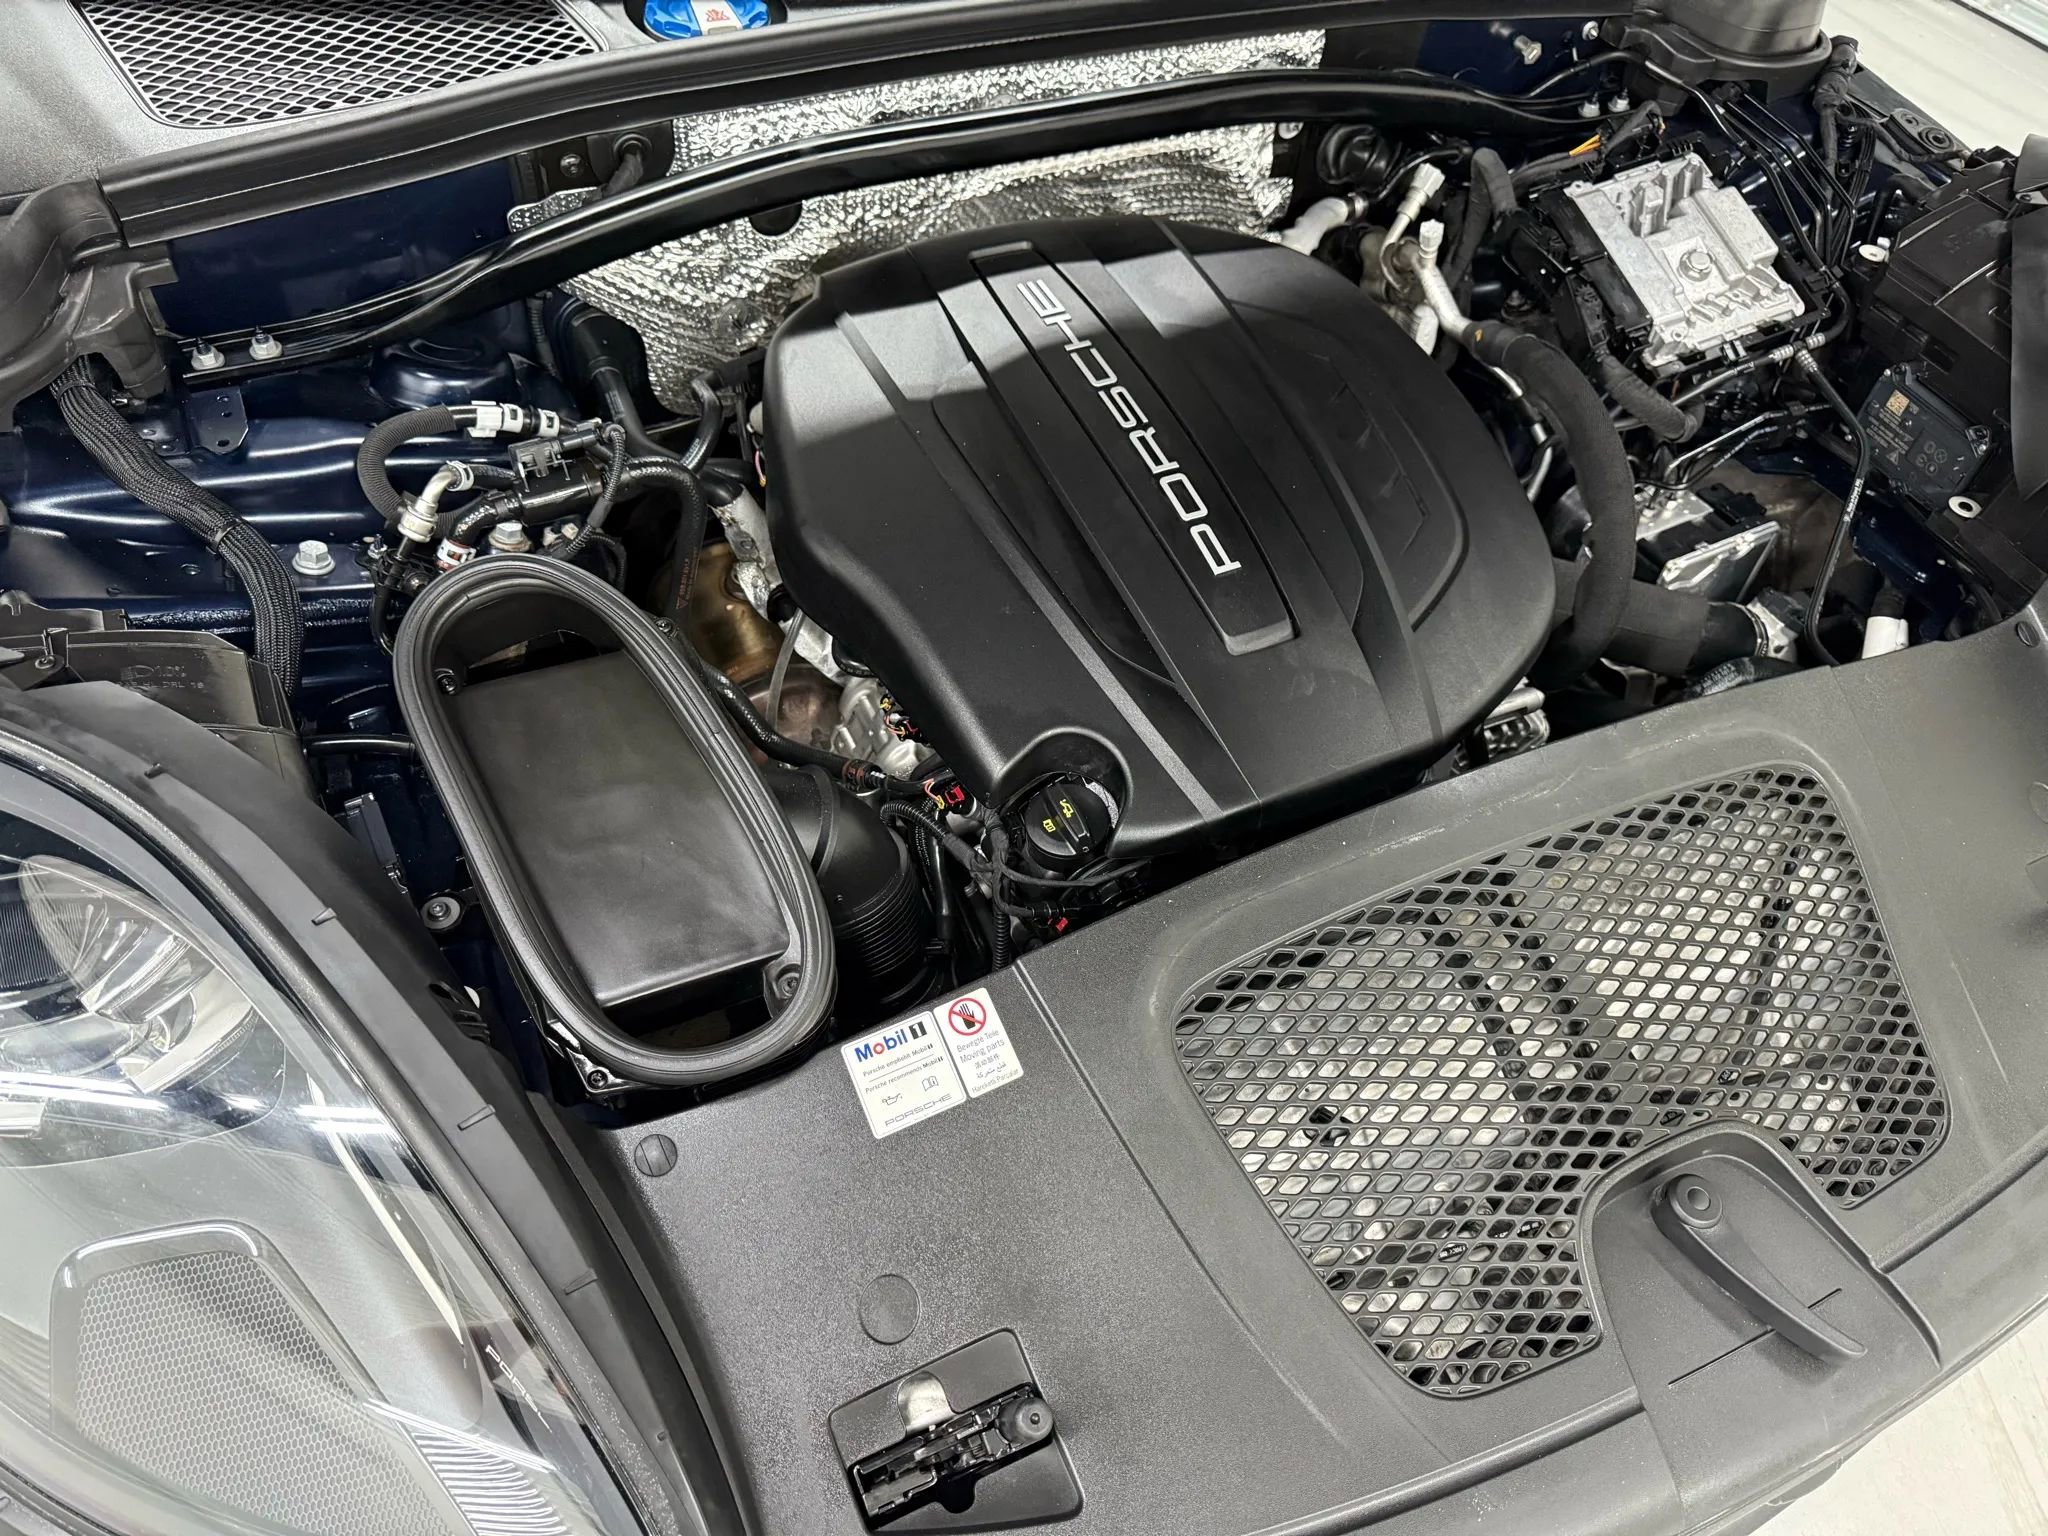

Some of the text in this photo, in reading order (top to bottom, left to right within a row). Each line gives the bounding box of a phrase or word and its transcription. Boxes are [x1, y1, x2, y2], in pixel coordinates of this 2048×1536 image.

[1016, 279, 1242, 576] PORSCHE
[854, 1023, 925, 1062] Mobil 1
[957, 1036, 985, 1053] Bewegte
[960, 1039, 1005, 1063] Moving parts
[863, 1064, 886, 1077] Porsche
[911, 1046, 928, 1057] Mobil
[865, 1080, 887, 1094] Porsche
[888, 1066, 923, 1084] recommends
[922, 1058, 939, 1069] Mobil
[884, 1093, 952, 1126] PORSCHE
[485, 1344, 553, 1433] PORS
